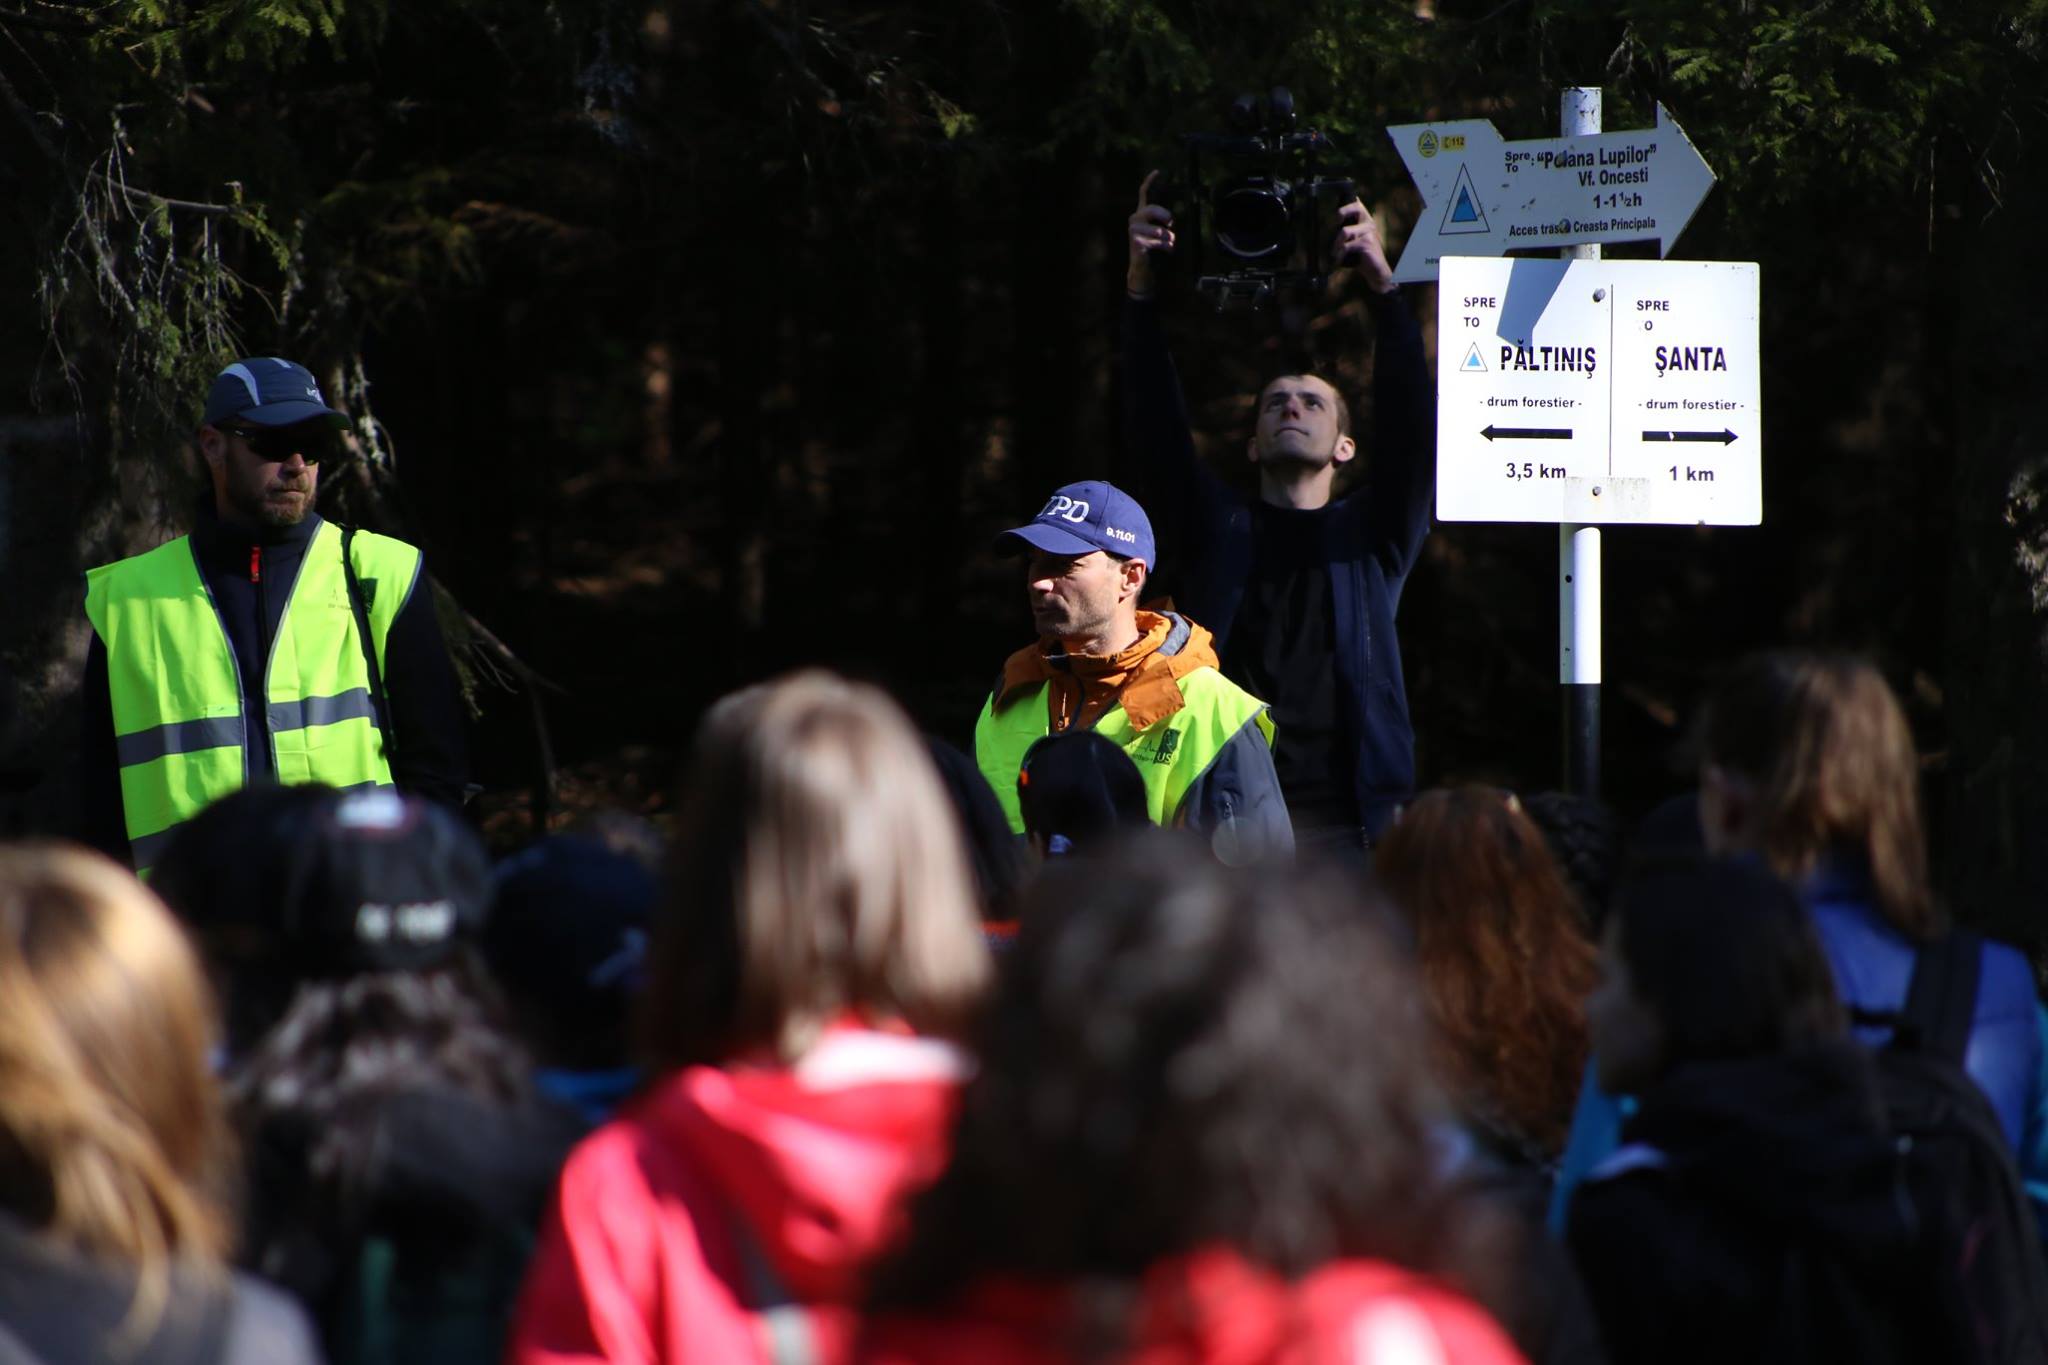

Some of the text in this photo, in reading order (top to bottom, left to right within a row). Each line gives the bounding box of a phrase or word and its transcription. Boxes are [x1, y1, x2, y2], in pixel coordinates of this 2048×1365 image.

[1599, 143, 1657, 168] Lupilor”
[1505, 162, 1519, 173] To
[1578, 166, 1649, 187] Vf. Oncesti
[1509, 223, 1538, 236] Acces
[1573, 219, 1608, 233] Creasta
[1611, 216, 1656, 231] Principala
[1463, 296, 1496, 308] SPRE
[1636, 299, 1670, 311] SPRE
[1463, 316, 1480, 328] TO
[1487, 396, 1518, 407] drum
[1522, 396, 1575, 408] forestier
[1646, 399, 1678, 409] drum
[1682, 399, 1737, 410] forestier
[1506, 462, 1567, 481] 3,5 km
[1669, 465, 1714, 481] 1 km
